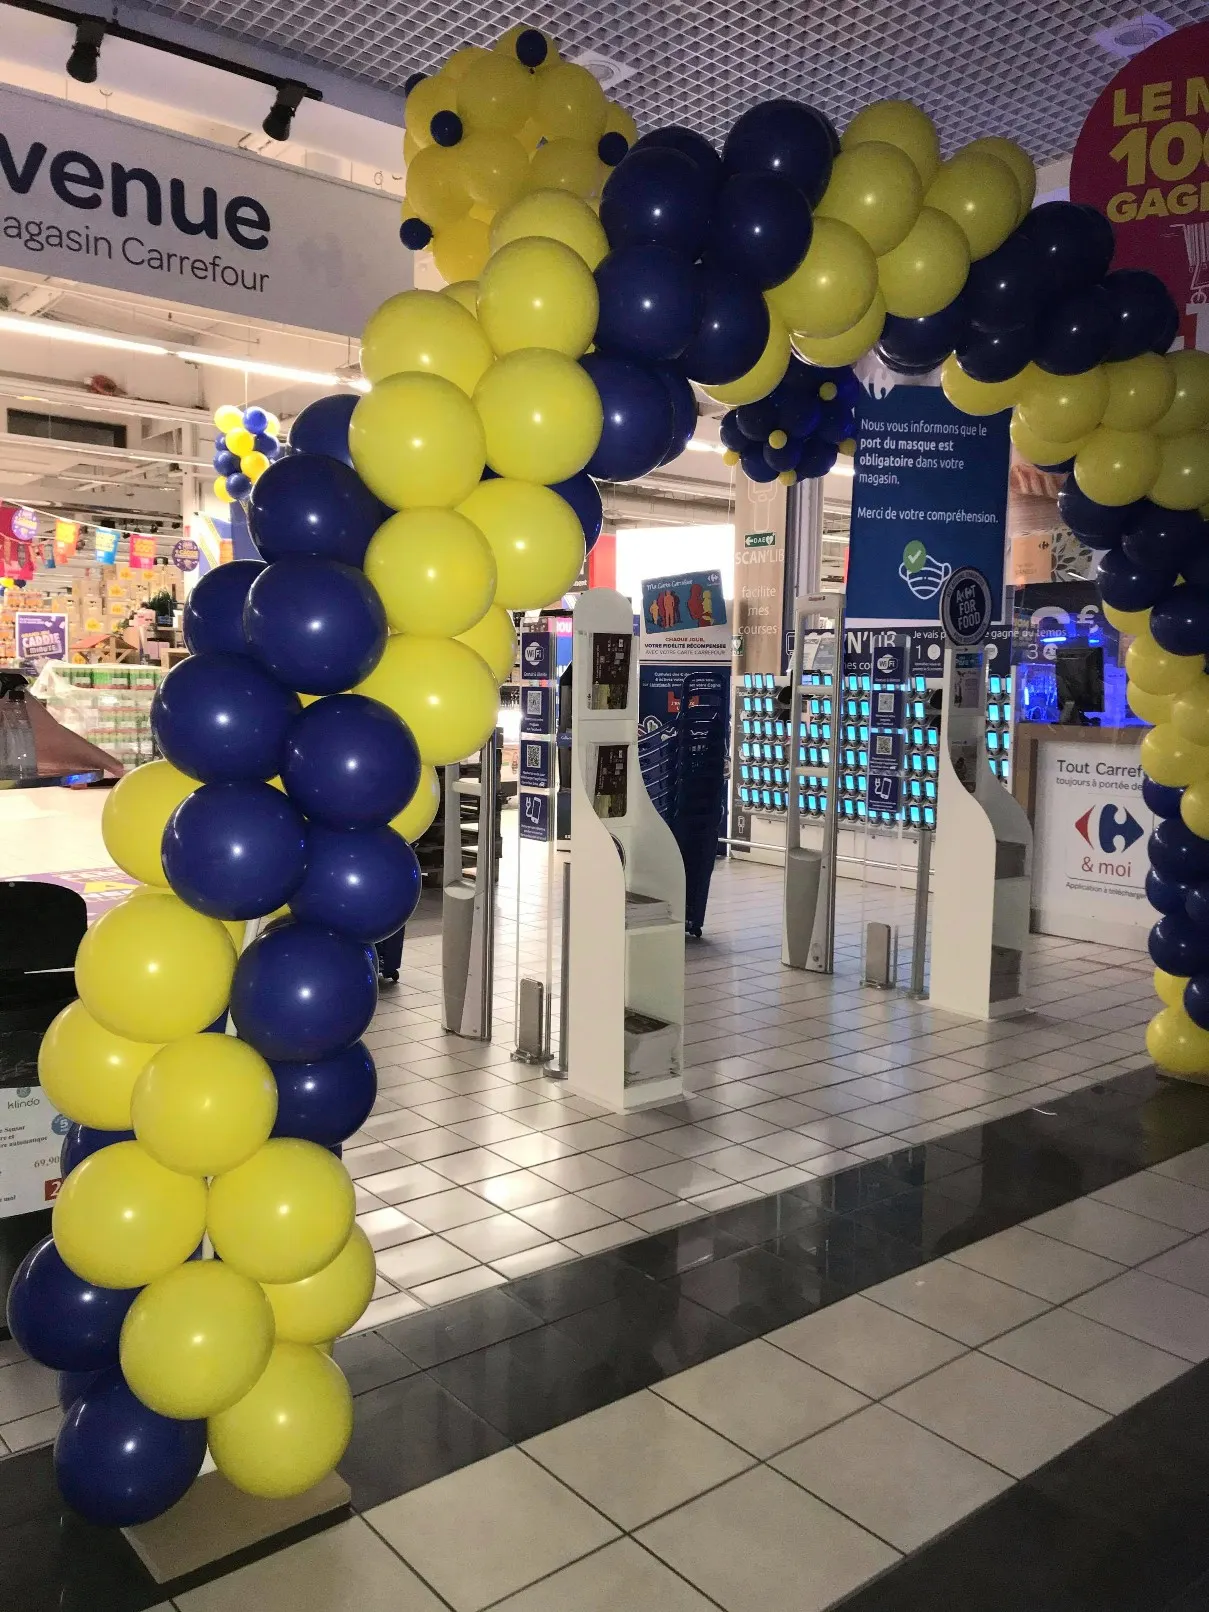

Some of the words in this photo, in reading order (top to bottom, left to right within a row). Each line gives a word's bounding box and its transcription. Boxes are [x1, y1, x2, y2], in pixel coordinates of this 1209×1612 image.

[1113, 80, 1173, 128] LE
[1109, 121, 1209, 187] 10
[121, 235, 271, 294] Carrefour
[860, 418, 885, 432] Nous
[887, 421, 909, 433] vous
[910, 420, 959, 435] informons
[960, 425, 978, 438] que
[979, 423, 988, 437] le
[860, 437, 881, 451] port
[884, 436, 896, 450] du
[898, 439, 936, 453] masque
[938, 440, 954, 452] est
[859, 452, 914, 469] obligatoire
[915, 456, 938, 469] dans
[940, 458, 966, 470] votre
[858, 472, 901, 487] magasin.
[857, 506, 884, 520] Merci
[885, 506, 897, 520] de
[899, 508, 925, 521] votre
[926, 508, 1000, 525] compréhension.
[741, 585, 777, 599] facilite
[748, 606, 770, 617] mes
[959, 599, 977, 616] FOR
[957, 611, 981, 631] FOOD
[738, 624, 779, 636] courses
[912, 630, 922, 640] Je
[924, 630, 941, 640] vais
[990, 629, 1020, 641] gagne
[1021, 628, 1034, 638] du
[1036, 628, 1067, 640] temps
[915, 644, 922, 660] 1
[1026, 643, 1039, 660] 3
[1057, 759, 1091, 775] Tout
[1096, 761, 1143, 779] Carref
[1056, 776, 1090, 789] toujours
[1099, 779, 1130, 791] portée
[1081, 856, 1094, 874] &
[1099, 861, 1132, 878] moi
[7, 1097, 41, 1110] klindo
